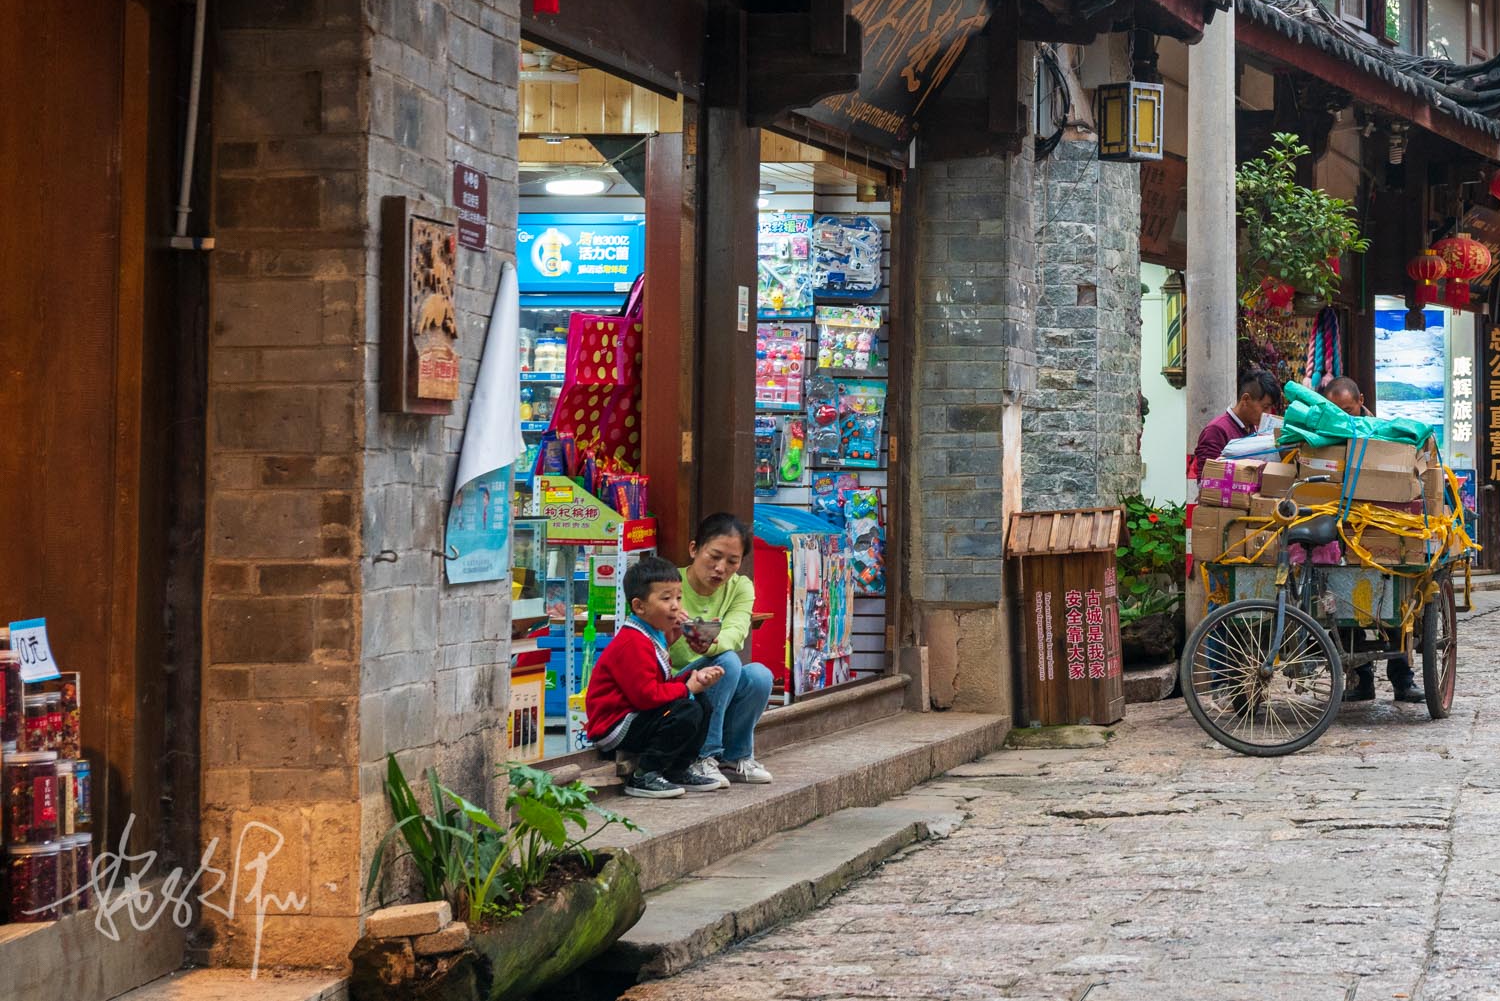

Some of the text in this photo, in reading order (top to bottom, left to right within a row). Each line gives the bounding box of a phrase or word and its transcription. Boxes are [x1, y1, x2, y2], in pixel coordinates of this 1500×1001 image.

[845, 92, 906, 134] Supermarket
[1452, 356, 1472, 442] 康辉旅游
[545, 507, 599, 518] 枸杞槟榔
[1066, 590, 1085, 680] 安全靠大家
[1085, 589, 1105, 679] 古城是我家
